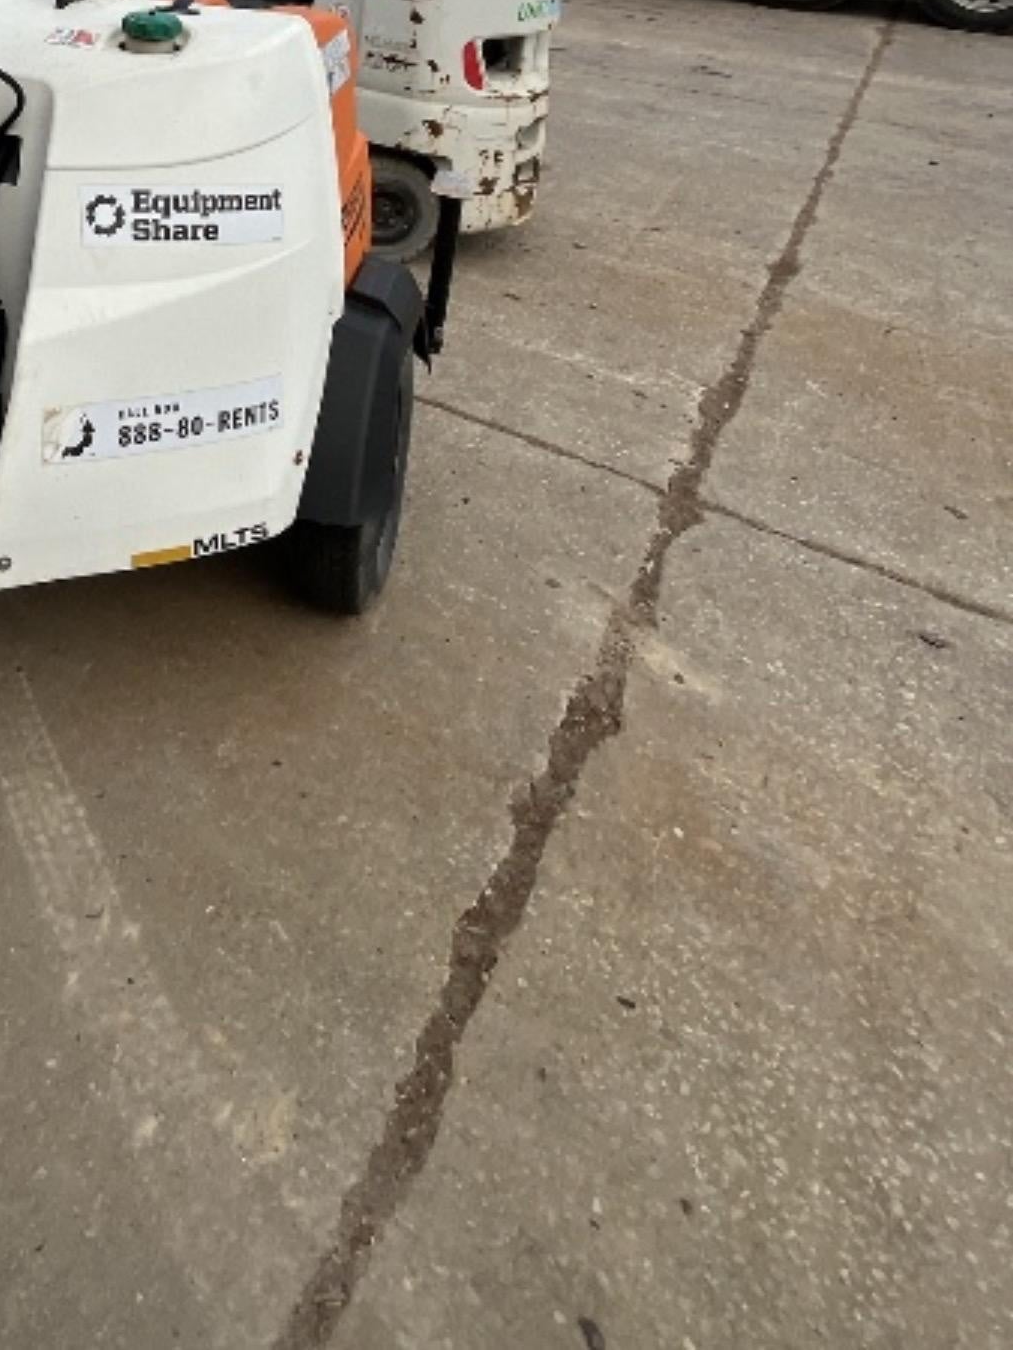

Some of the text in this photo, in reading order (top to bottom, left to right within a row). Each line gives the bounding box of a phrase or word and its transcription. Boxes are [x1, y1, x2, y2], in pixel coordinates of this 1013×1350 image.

[130, 188, 283, 218] Equipment
[132, 219, 220, 241] Share
[118, 398, 280, 448] 888-80-RENTS
